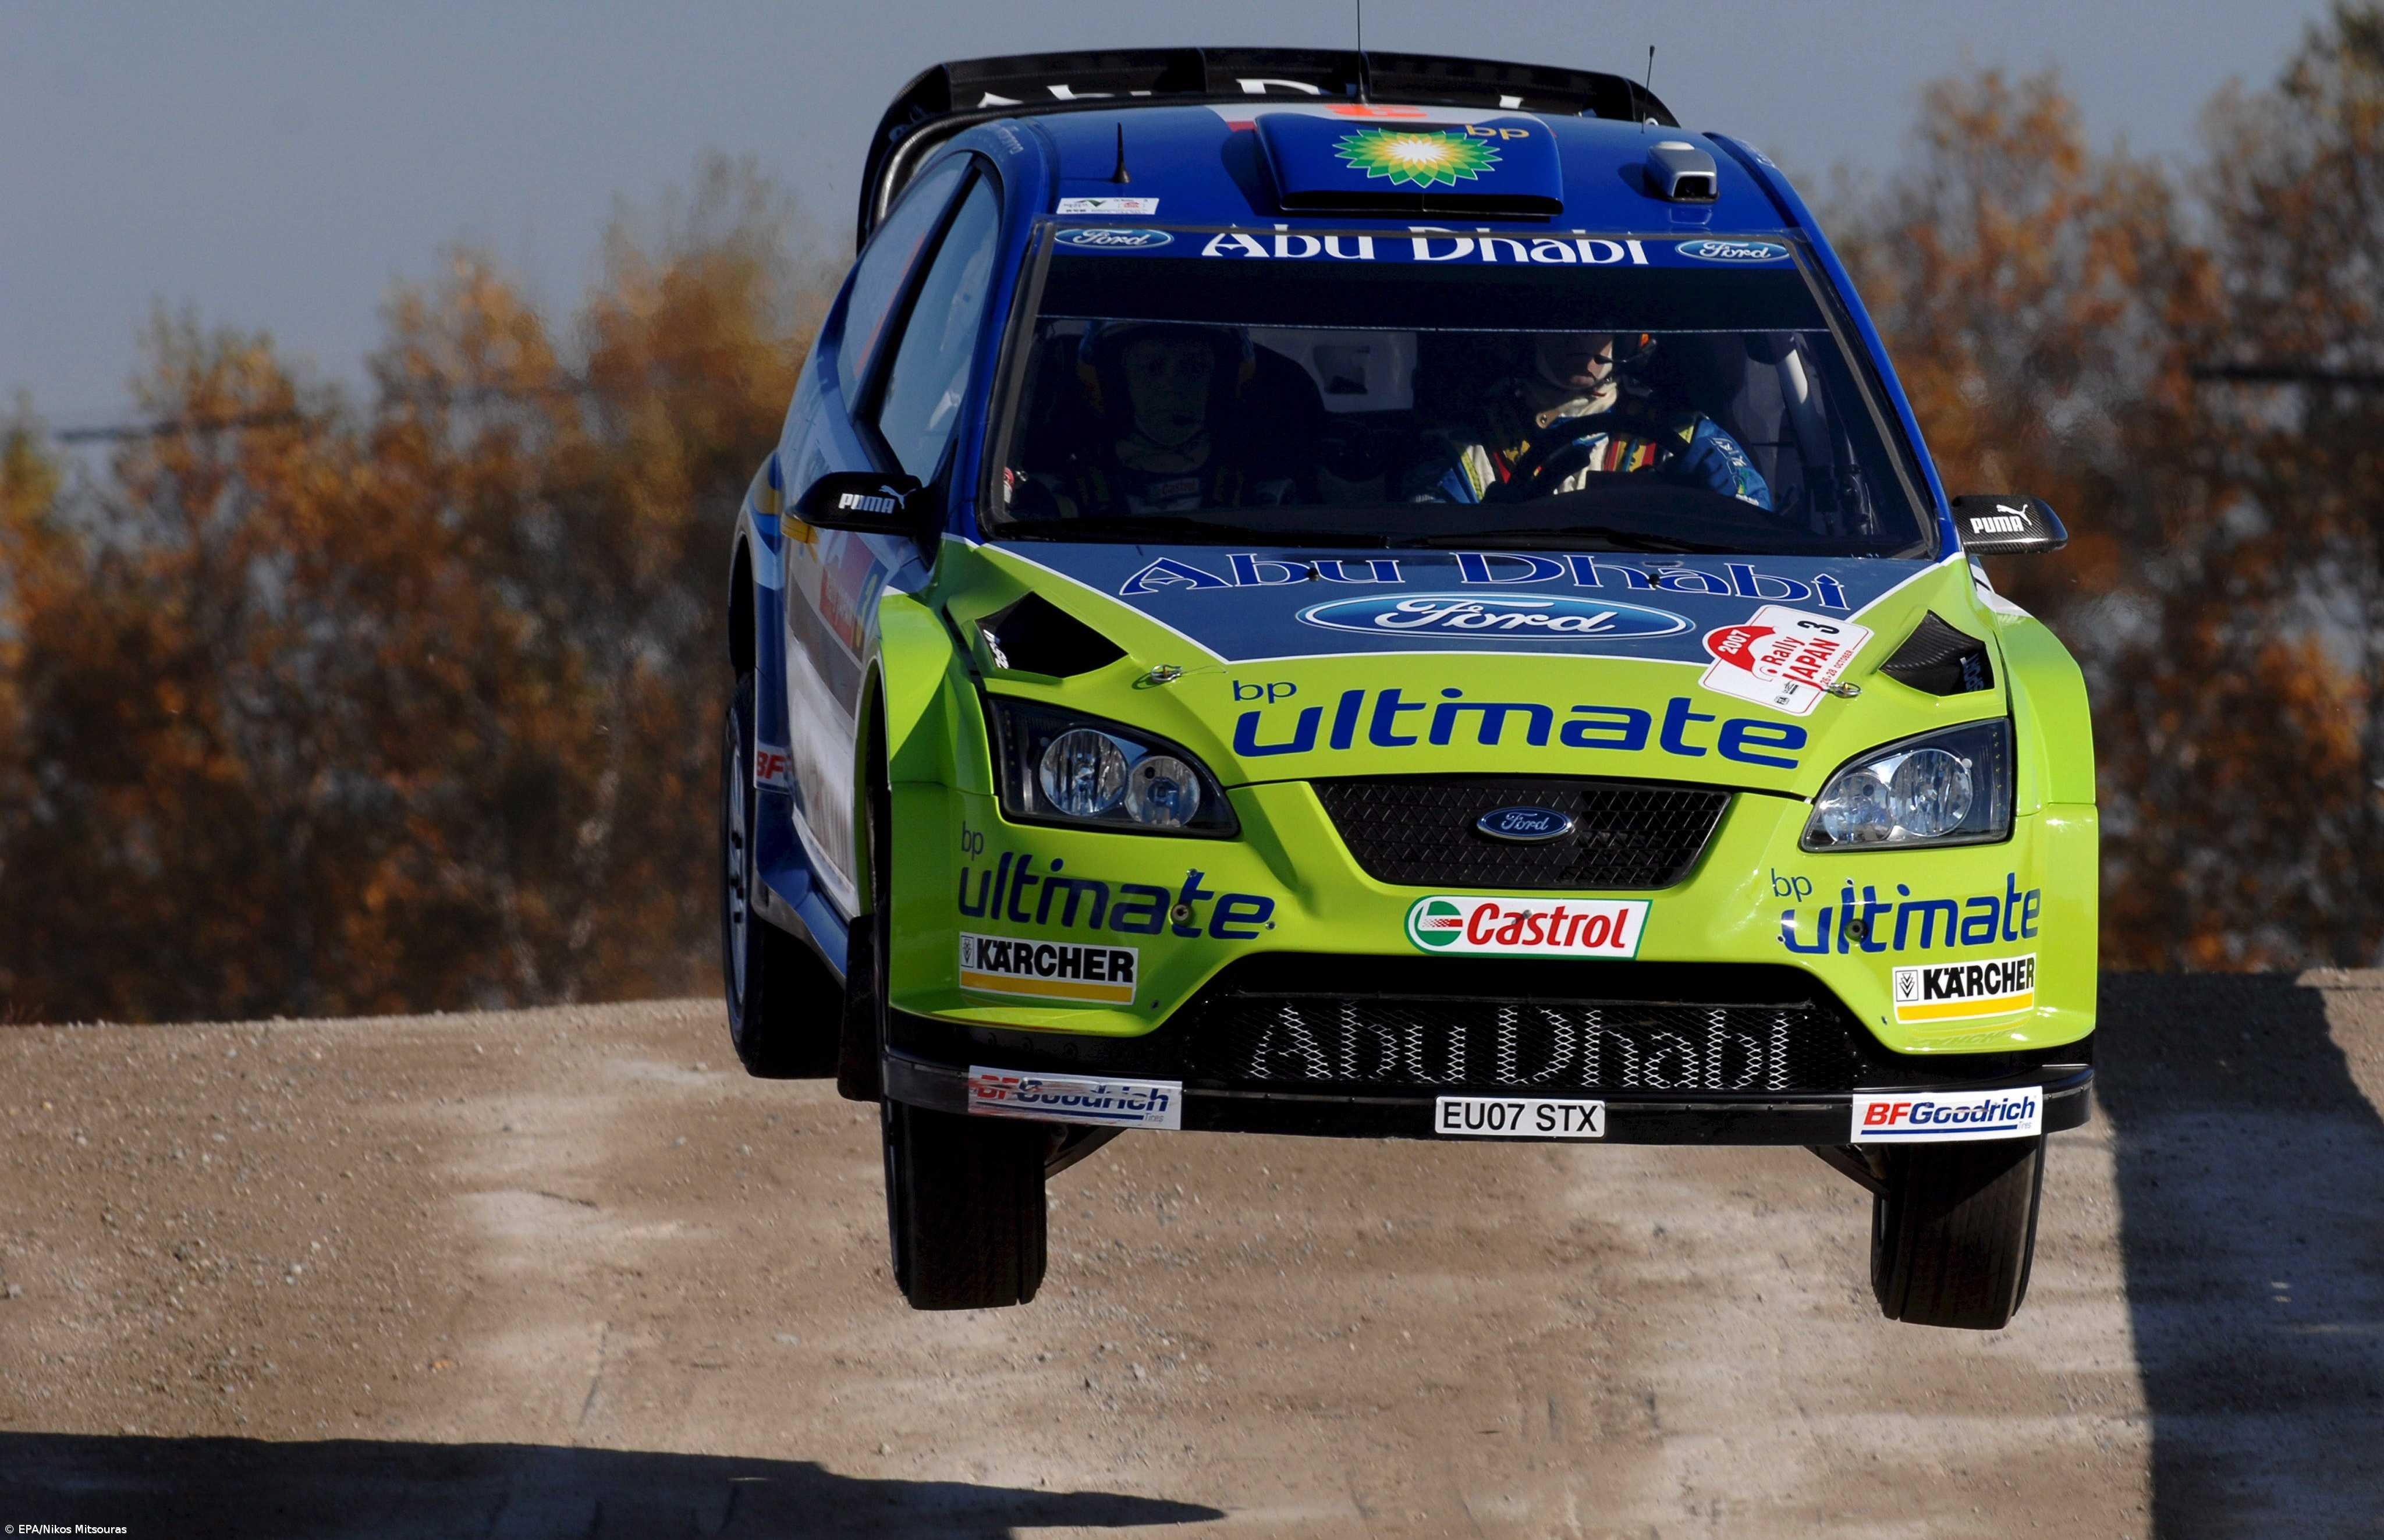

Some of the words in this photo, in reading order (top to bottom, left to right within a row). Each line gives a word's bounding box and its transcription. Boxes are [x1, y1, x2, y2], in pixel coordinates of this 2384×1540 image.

[1465, 125, 1530, 140] bp
[1073, 229, 1151, 246] Ford
[1201, 223, 1375, 260] Abu
[1409, 226, 1649, 265] Dhabi
[1699, 240, 1771, 260] Ford
[839, 493, 895, 514] PUMA
[1970, 516, 2024, 534] PUMA
[1119, 553, 1405, 595] Abu
[1449, 552, 1851, 611] Dhabi
[1374, 598, 1619, 633] Ford
[1797, 620, 1840, 634] 3
[1718, 629, 1751, 655] 2007
[1761, 636, 1805, 666] Rally
[1782, 637, 1840, 691] JAPAN
[1833, 649, 1854, 669] OCTOBER
[1233, 680, 1297, 704] bp
[1233, 687, 1808, 769] ultimate
[1500, 812, 1549, 831] Ford
[962, 821, 984, 860] bp
[958, 851, 1276, 939] ultimate
[1771, 868, 1812, 902] bp
[1466, 903, 1629, 948] Castrol
[1782, 872, 2041, 954] ultimate
[977, 937, 1134, 983] KÄRCHER
[1923, 957, 2035, 1000] KÄRCHER
[1247, 1000, 1468, 1084] Abu
[1496, 1005, 1790, 1091] Dhabi
[1443, 1101, 1526, 1131] EU07
[1535, 1103, 1599, 1132] STX
[1863, 1096, 2035, 1126] BFGoodrich
